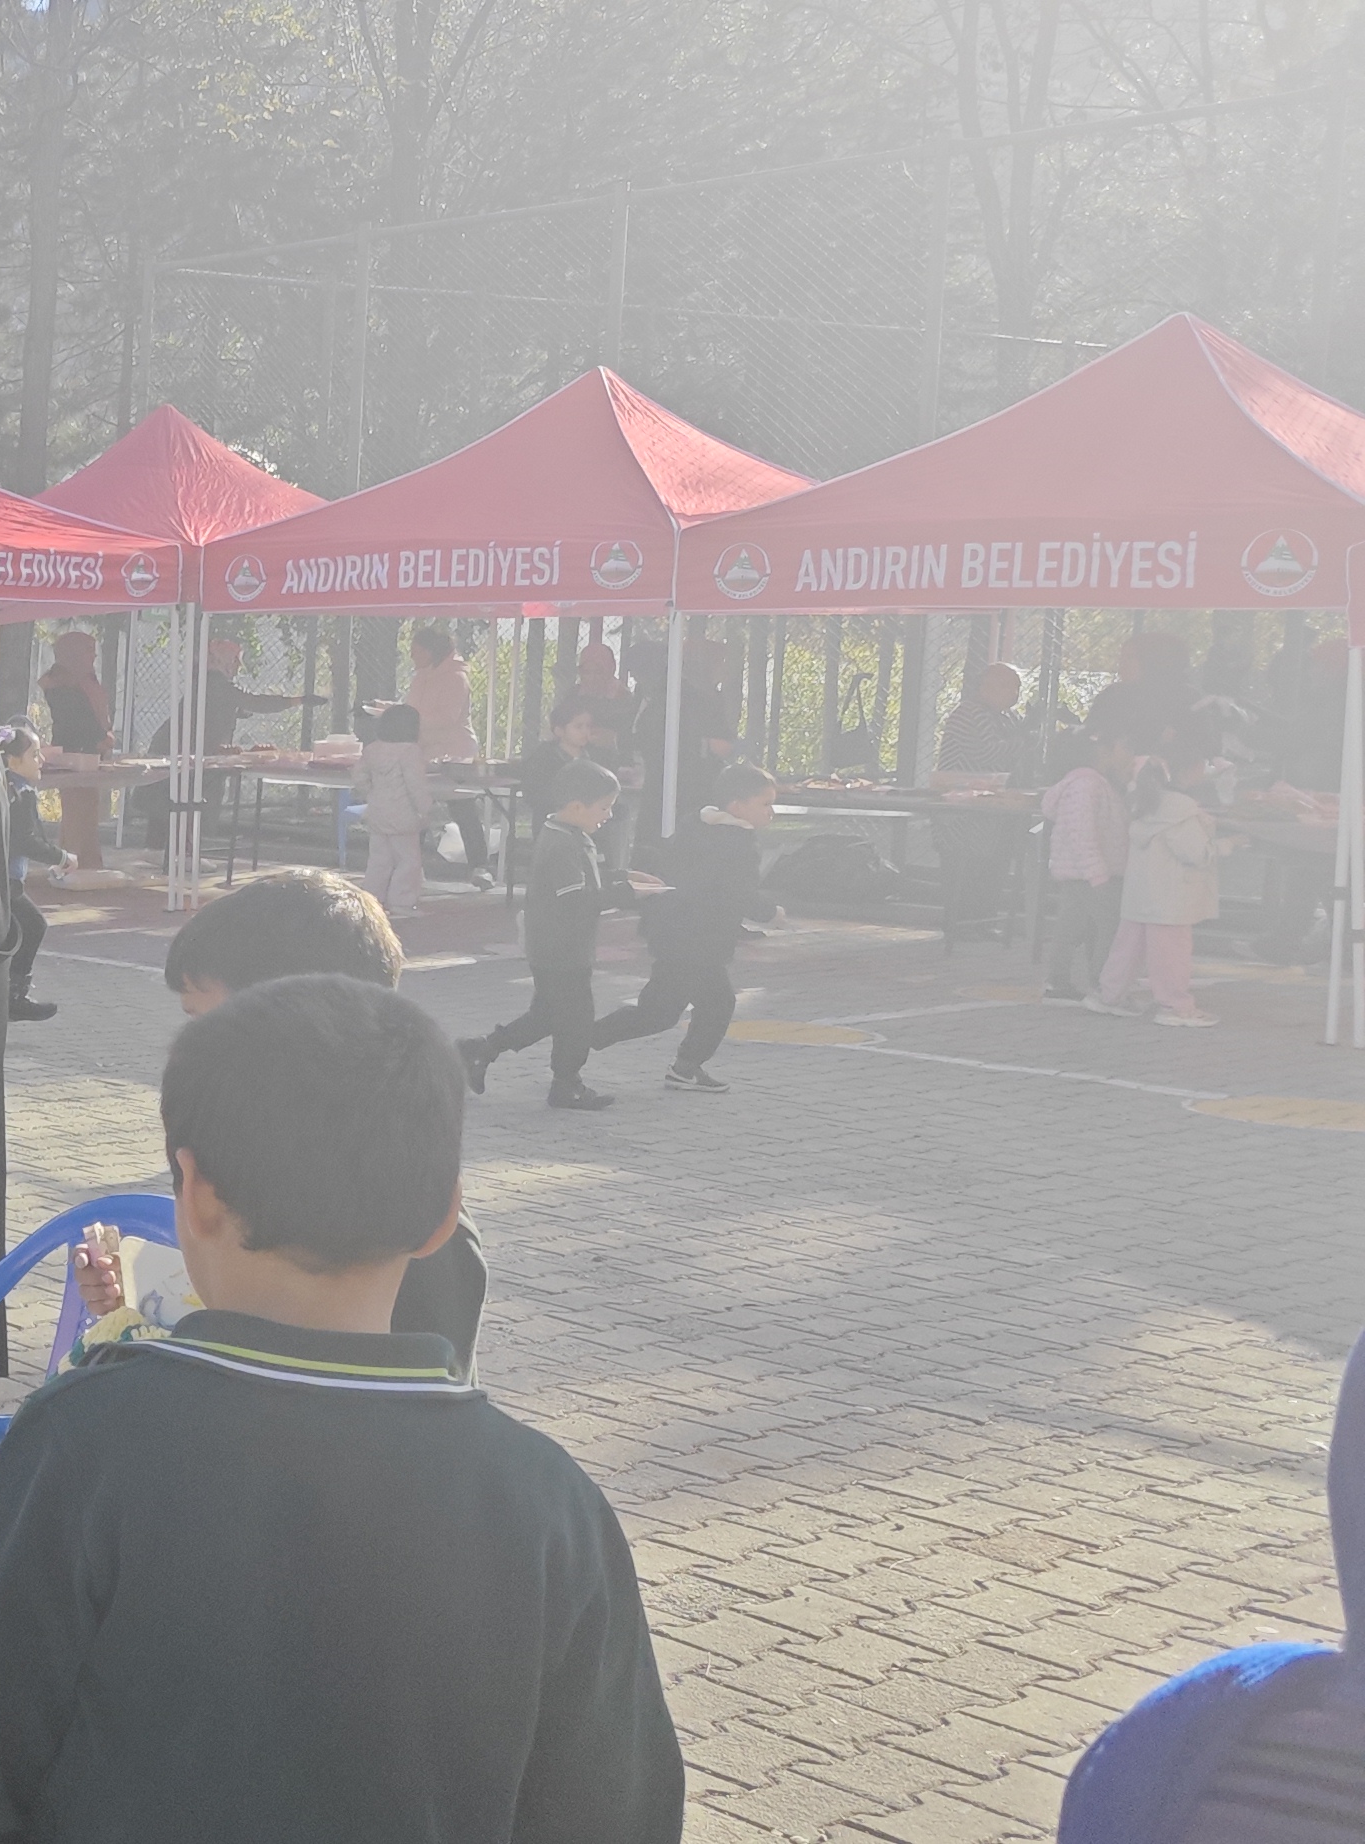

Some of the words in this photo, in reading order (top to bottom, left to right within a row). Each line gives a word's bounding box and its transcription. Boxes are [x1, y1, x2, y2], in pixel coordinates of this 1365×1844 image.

[280, 552, 390, 595] ANDIRIN
[398, 540, 562, 589] BELEDİYESİ
[794, 543, 948, 593] ANDIRIN
[961, 531, 1198, 590] BELEDİYESİ
